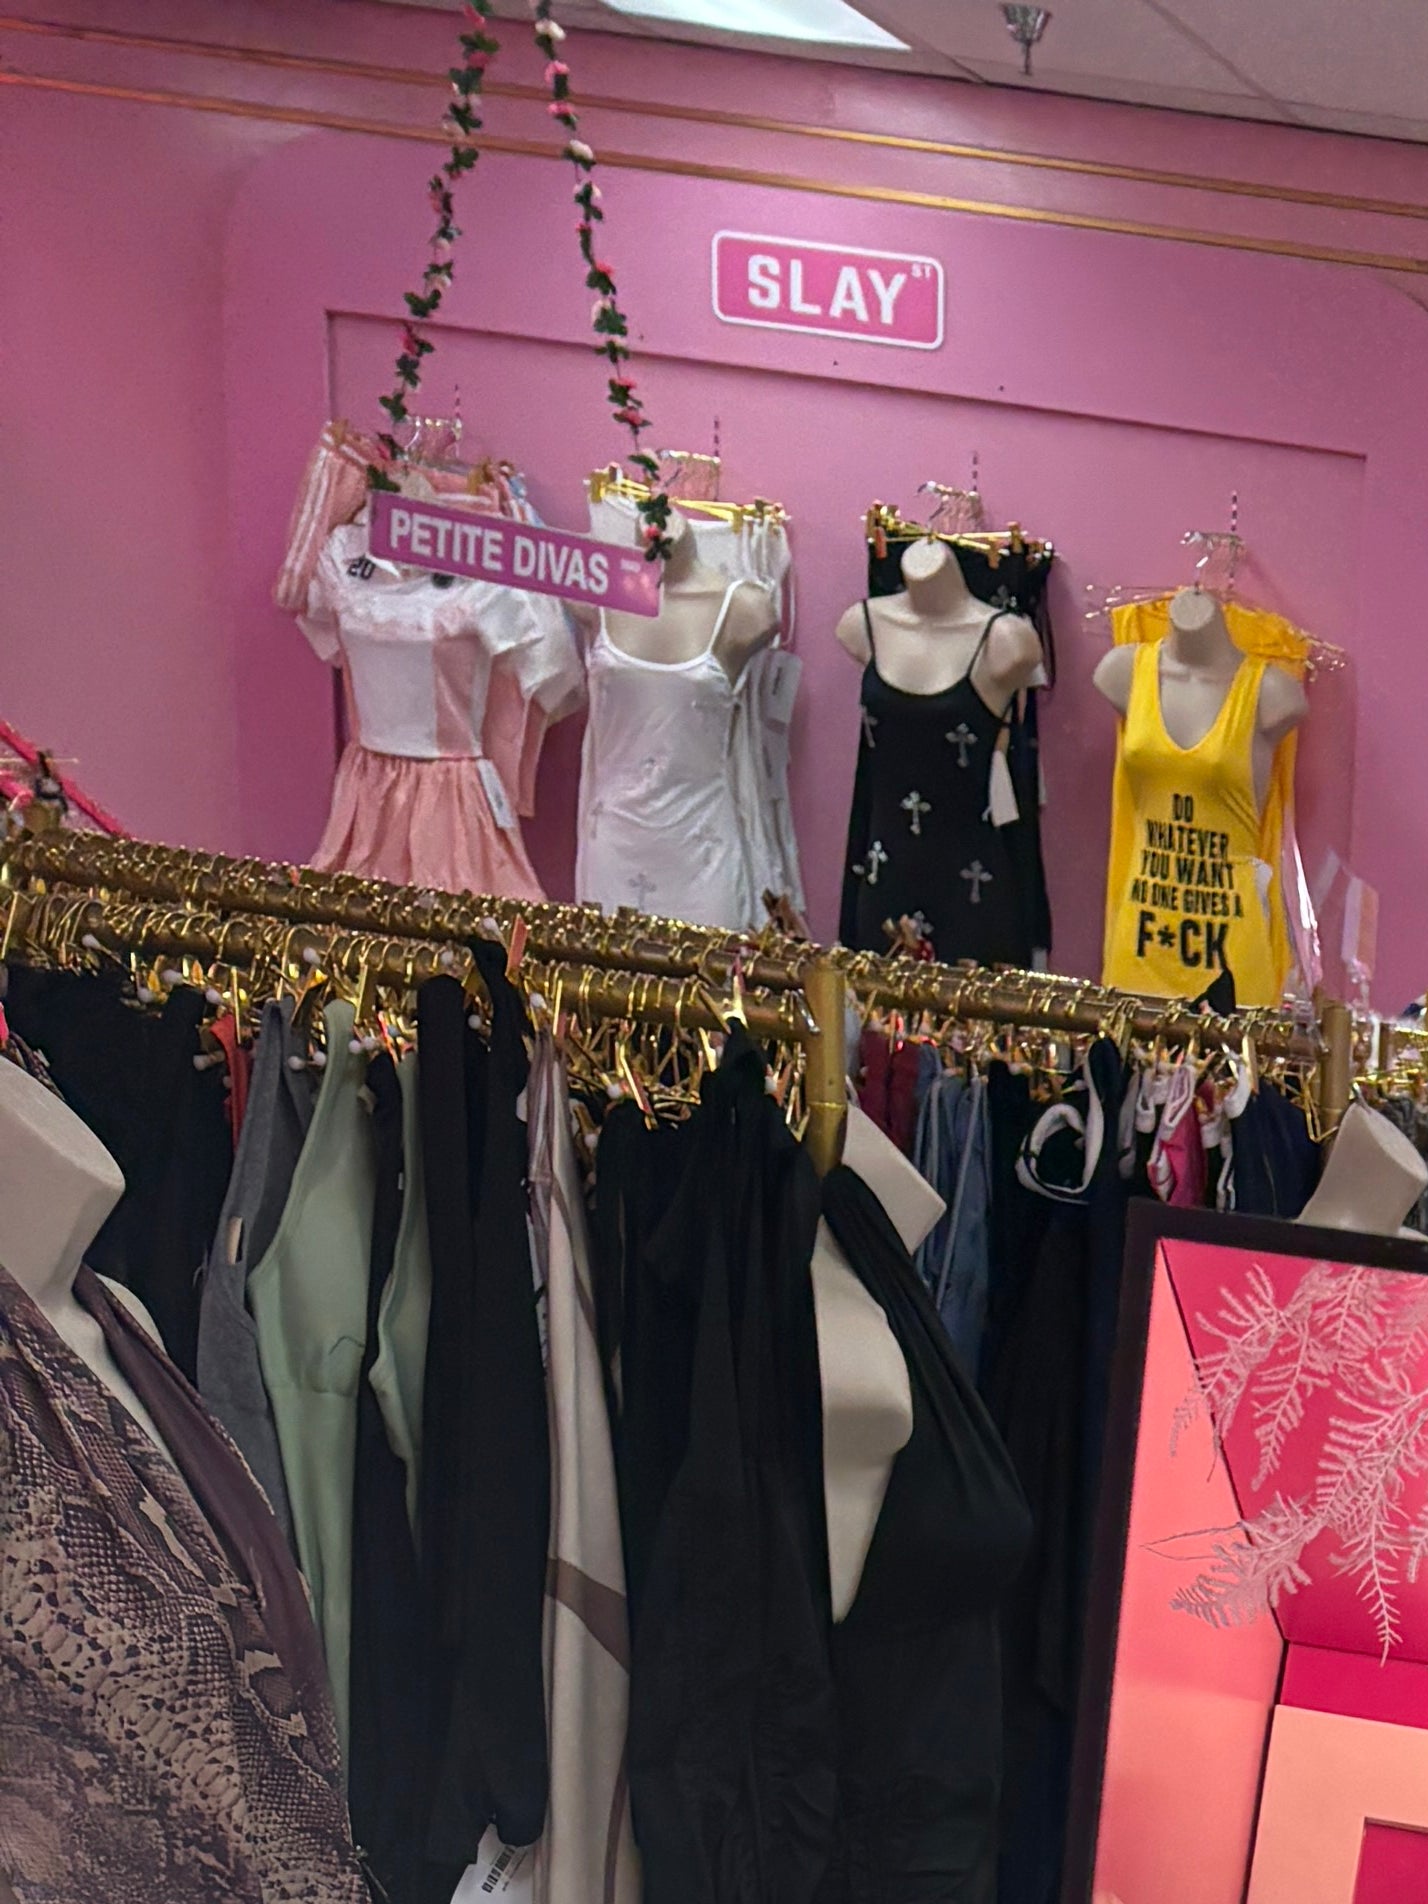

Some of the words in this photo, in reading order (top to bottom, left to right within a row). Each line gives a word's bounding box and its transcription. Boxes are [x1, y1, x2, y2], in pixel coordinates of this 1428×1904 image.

[748, 254, 907, 325] SLAY
[911, 263, 932, 280] ST
[390, 508, 504, 571] PETITE
[513, 535, 609, 595] DIVAS
[1173, 793, 1194, 822] DO
[1147, 819, 1229, 861] WHATEVER
[1141, 849, 1170, 880] YOU
[1176, 856, 1235, 890] WANT
[1151, 882, 1178, 911] ONE
[1182, 889, 1230, 917] GIVES
[1233, 893, 1244, 918] A
